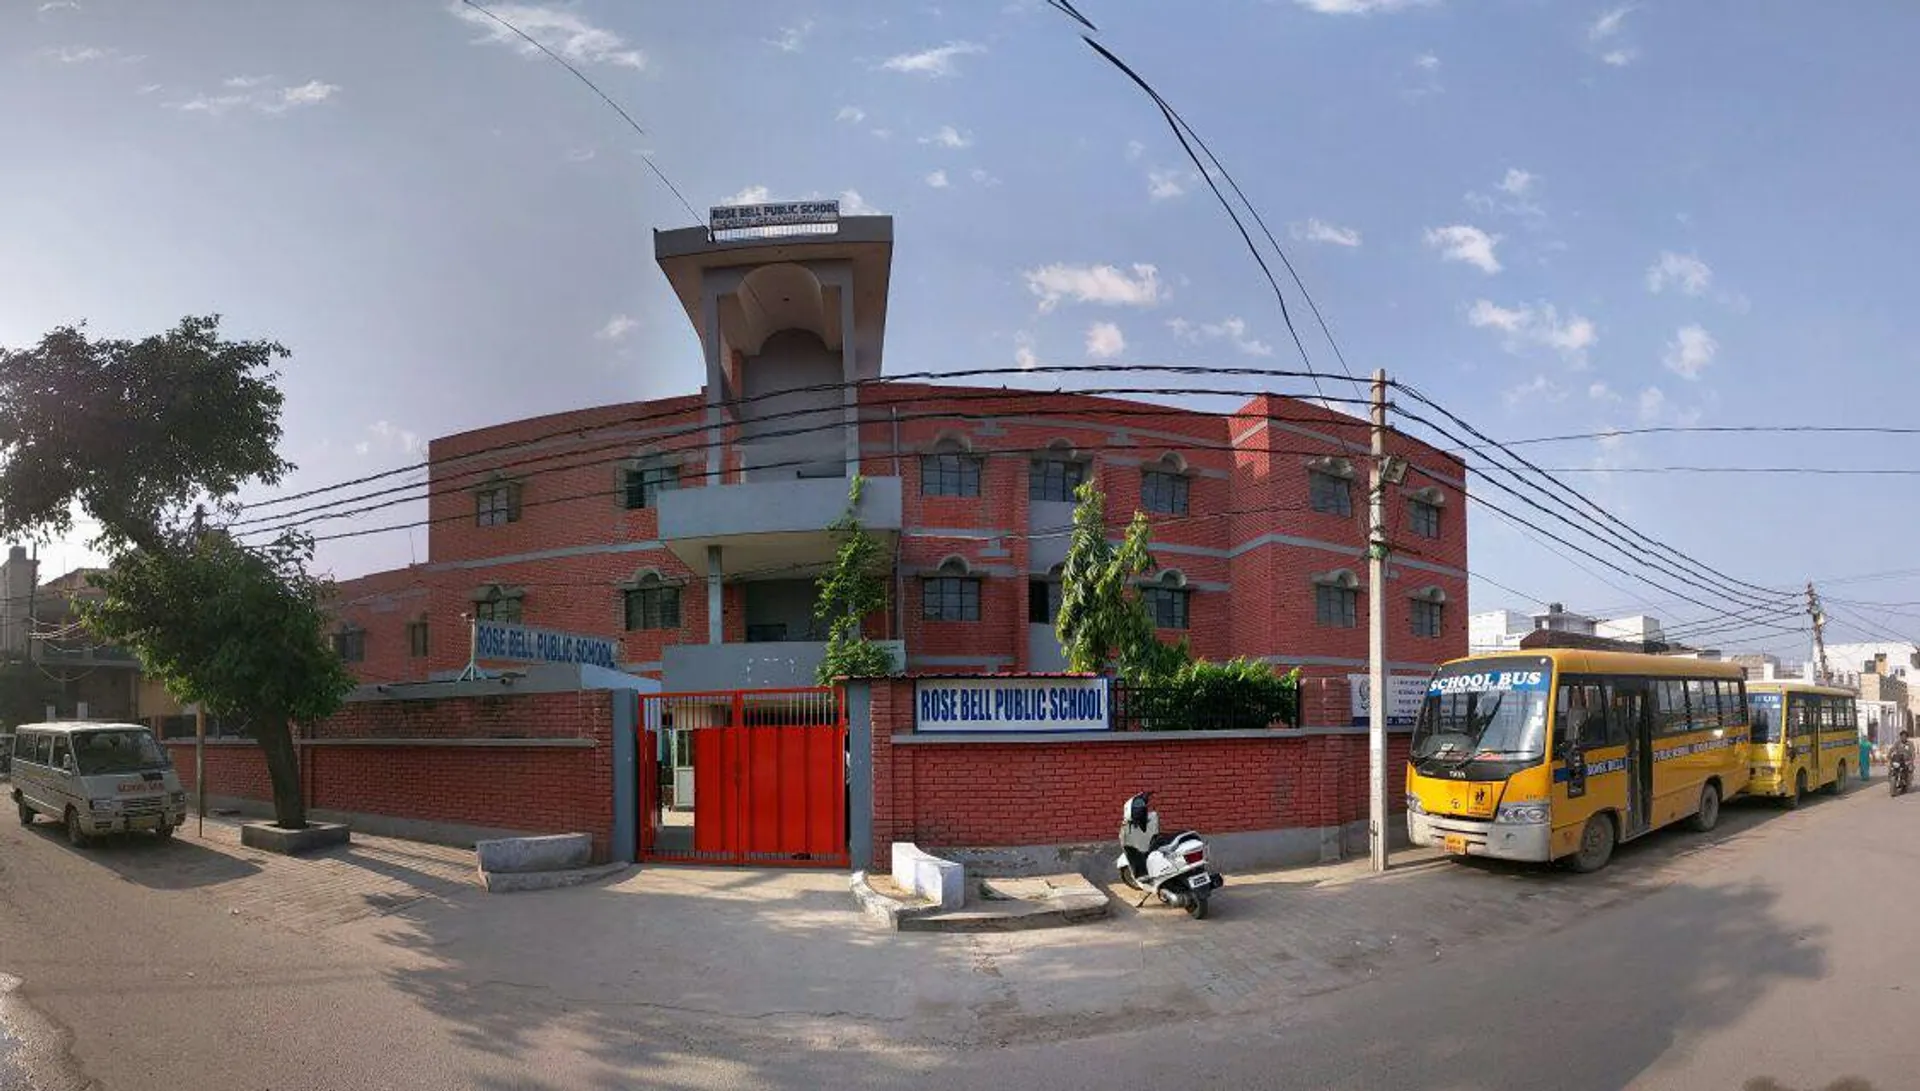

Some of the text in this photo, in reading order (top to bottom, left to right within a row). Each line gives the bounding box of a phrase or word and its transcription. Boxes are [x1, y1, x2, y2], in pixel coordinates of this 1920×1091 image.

[764, 204, 798, 216] PUBLIC
[799, 202, 838, 214] SCHOOL
[479, 626, 506, 655] ROSE
[508, 629, 534, 659] BELL
[537, 633, 573, 664] PUBLIC
[1429, 673, 1494, 692] SCHOOL
[1498, 671, 1541, 686] BUS
[921, 687, 1103, 722] ROSE BELL PUBLIC SCHOOL
